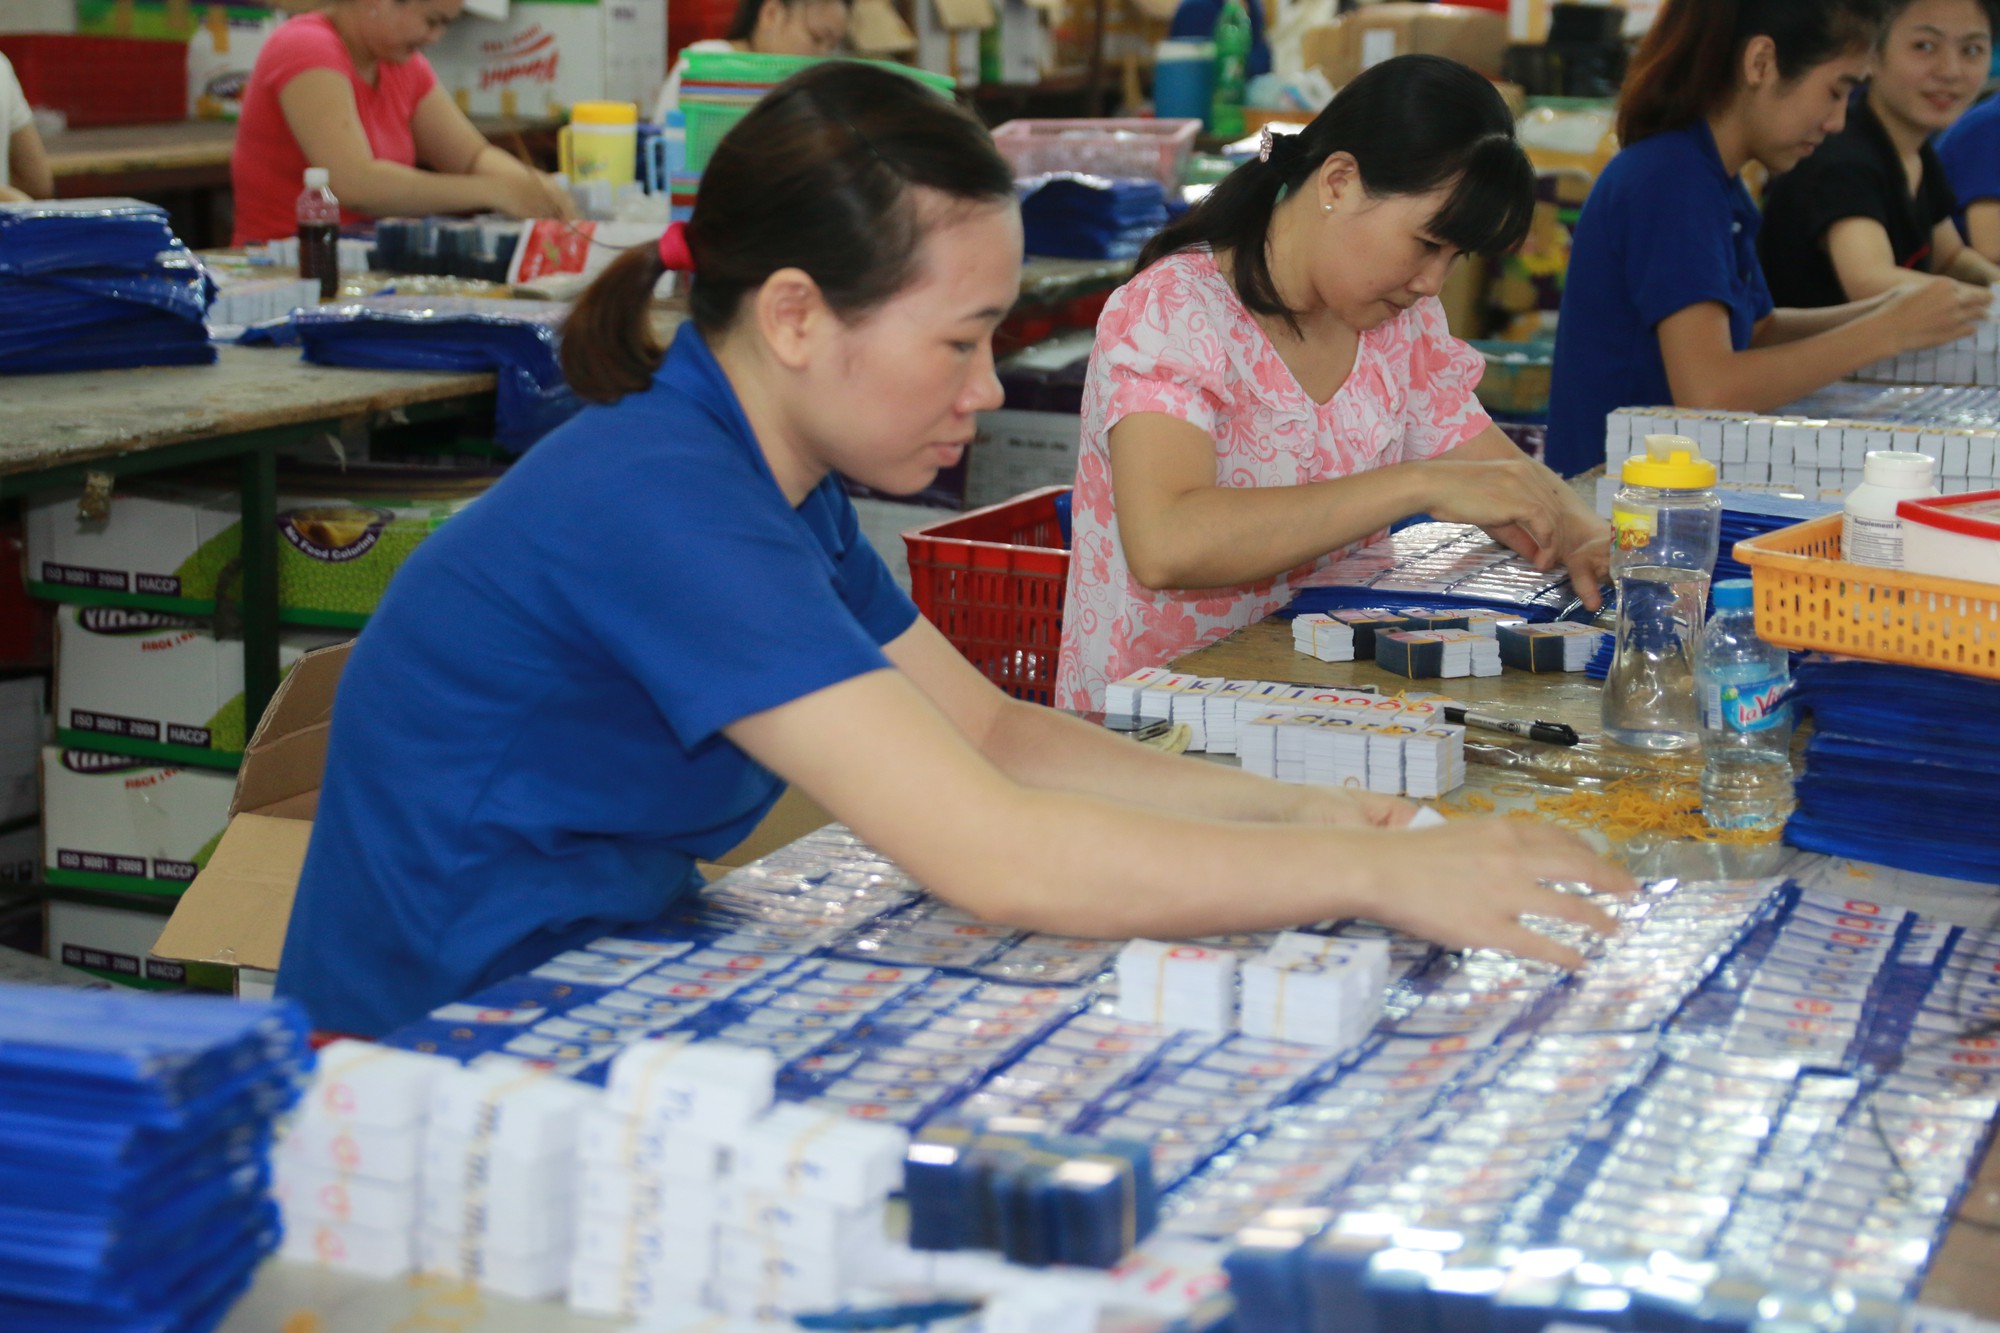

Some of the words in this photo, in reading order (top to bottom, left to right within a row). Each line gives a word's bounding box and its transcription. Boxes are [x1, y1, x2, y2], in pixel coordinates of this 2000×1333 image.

[300, 540, 329, 559] Food
[331, 533, 376, 560] Coloring
[139, 577, 178, 591] HACCP
[74, 713, 93, 726] ISO
[170, 728, 208, 743] HACCP
[61, 852, 80, 866] ISO
[157, 863, 195, 878] HACCP
[149, 963, 184, 978] HACCP
